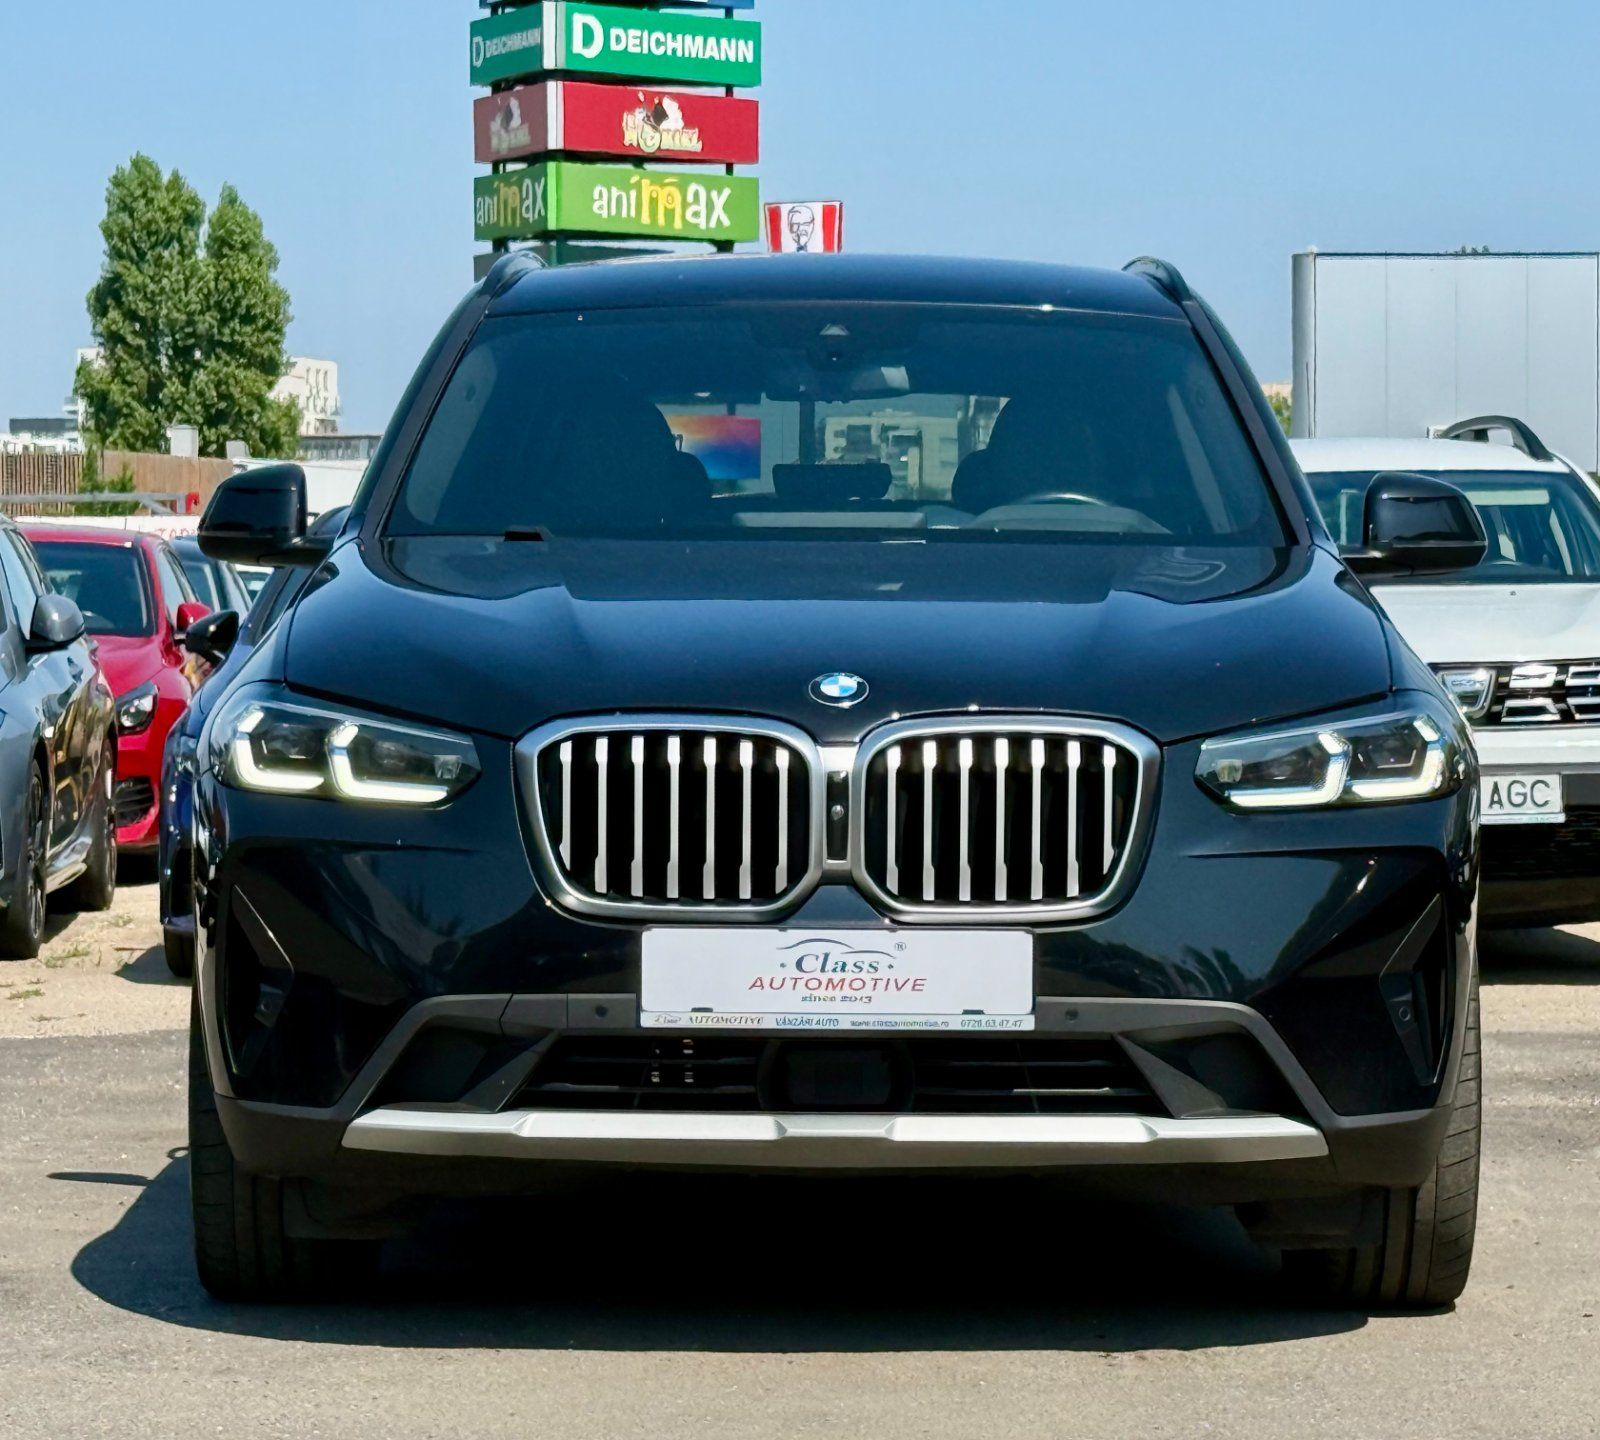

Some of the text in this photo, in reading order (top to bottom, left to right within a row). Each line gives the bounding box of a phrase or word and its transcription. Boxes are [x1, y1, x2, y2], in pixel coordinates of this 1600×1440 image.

[609, 27, 754, 64] DEICHMANN
[476, 176, 546, 228] animax
[592, 174, 732, 230] animax
[1488, 780, 1551, 809] AGC
[795, 951, 880, 974] Class
[748, 976, 928, 992] AUTOMOTIVE
[814, 1017, 840, 1027] AUTO
